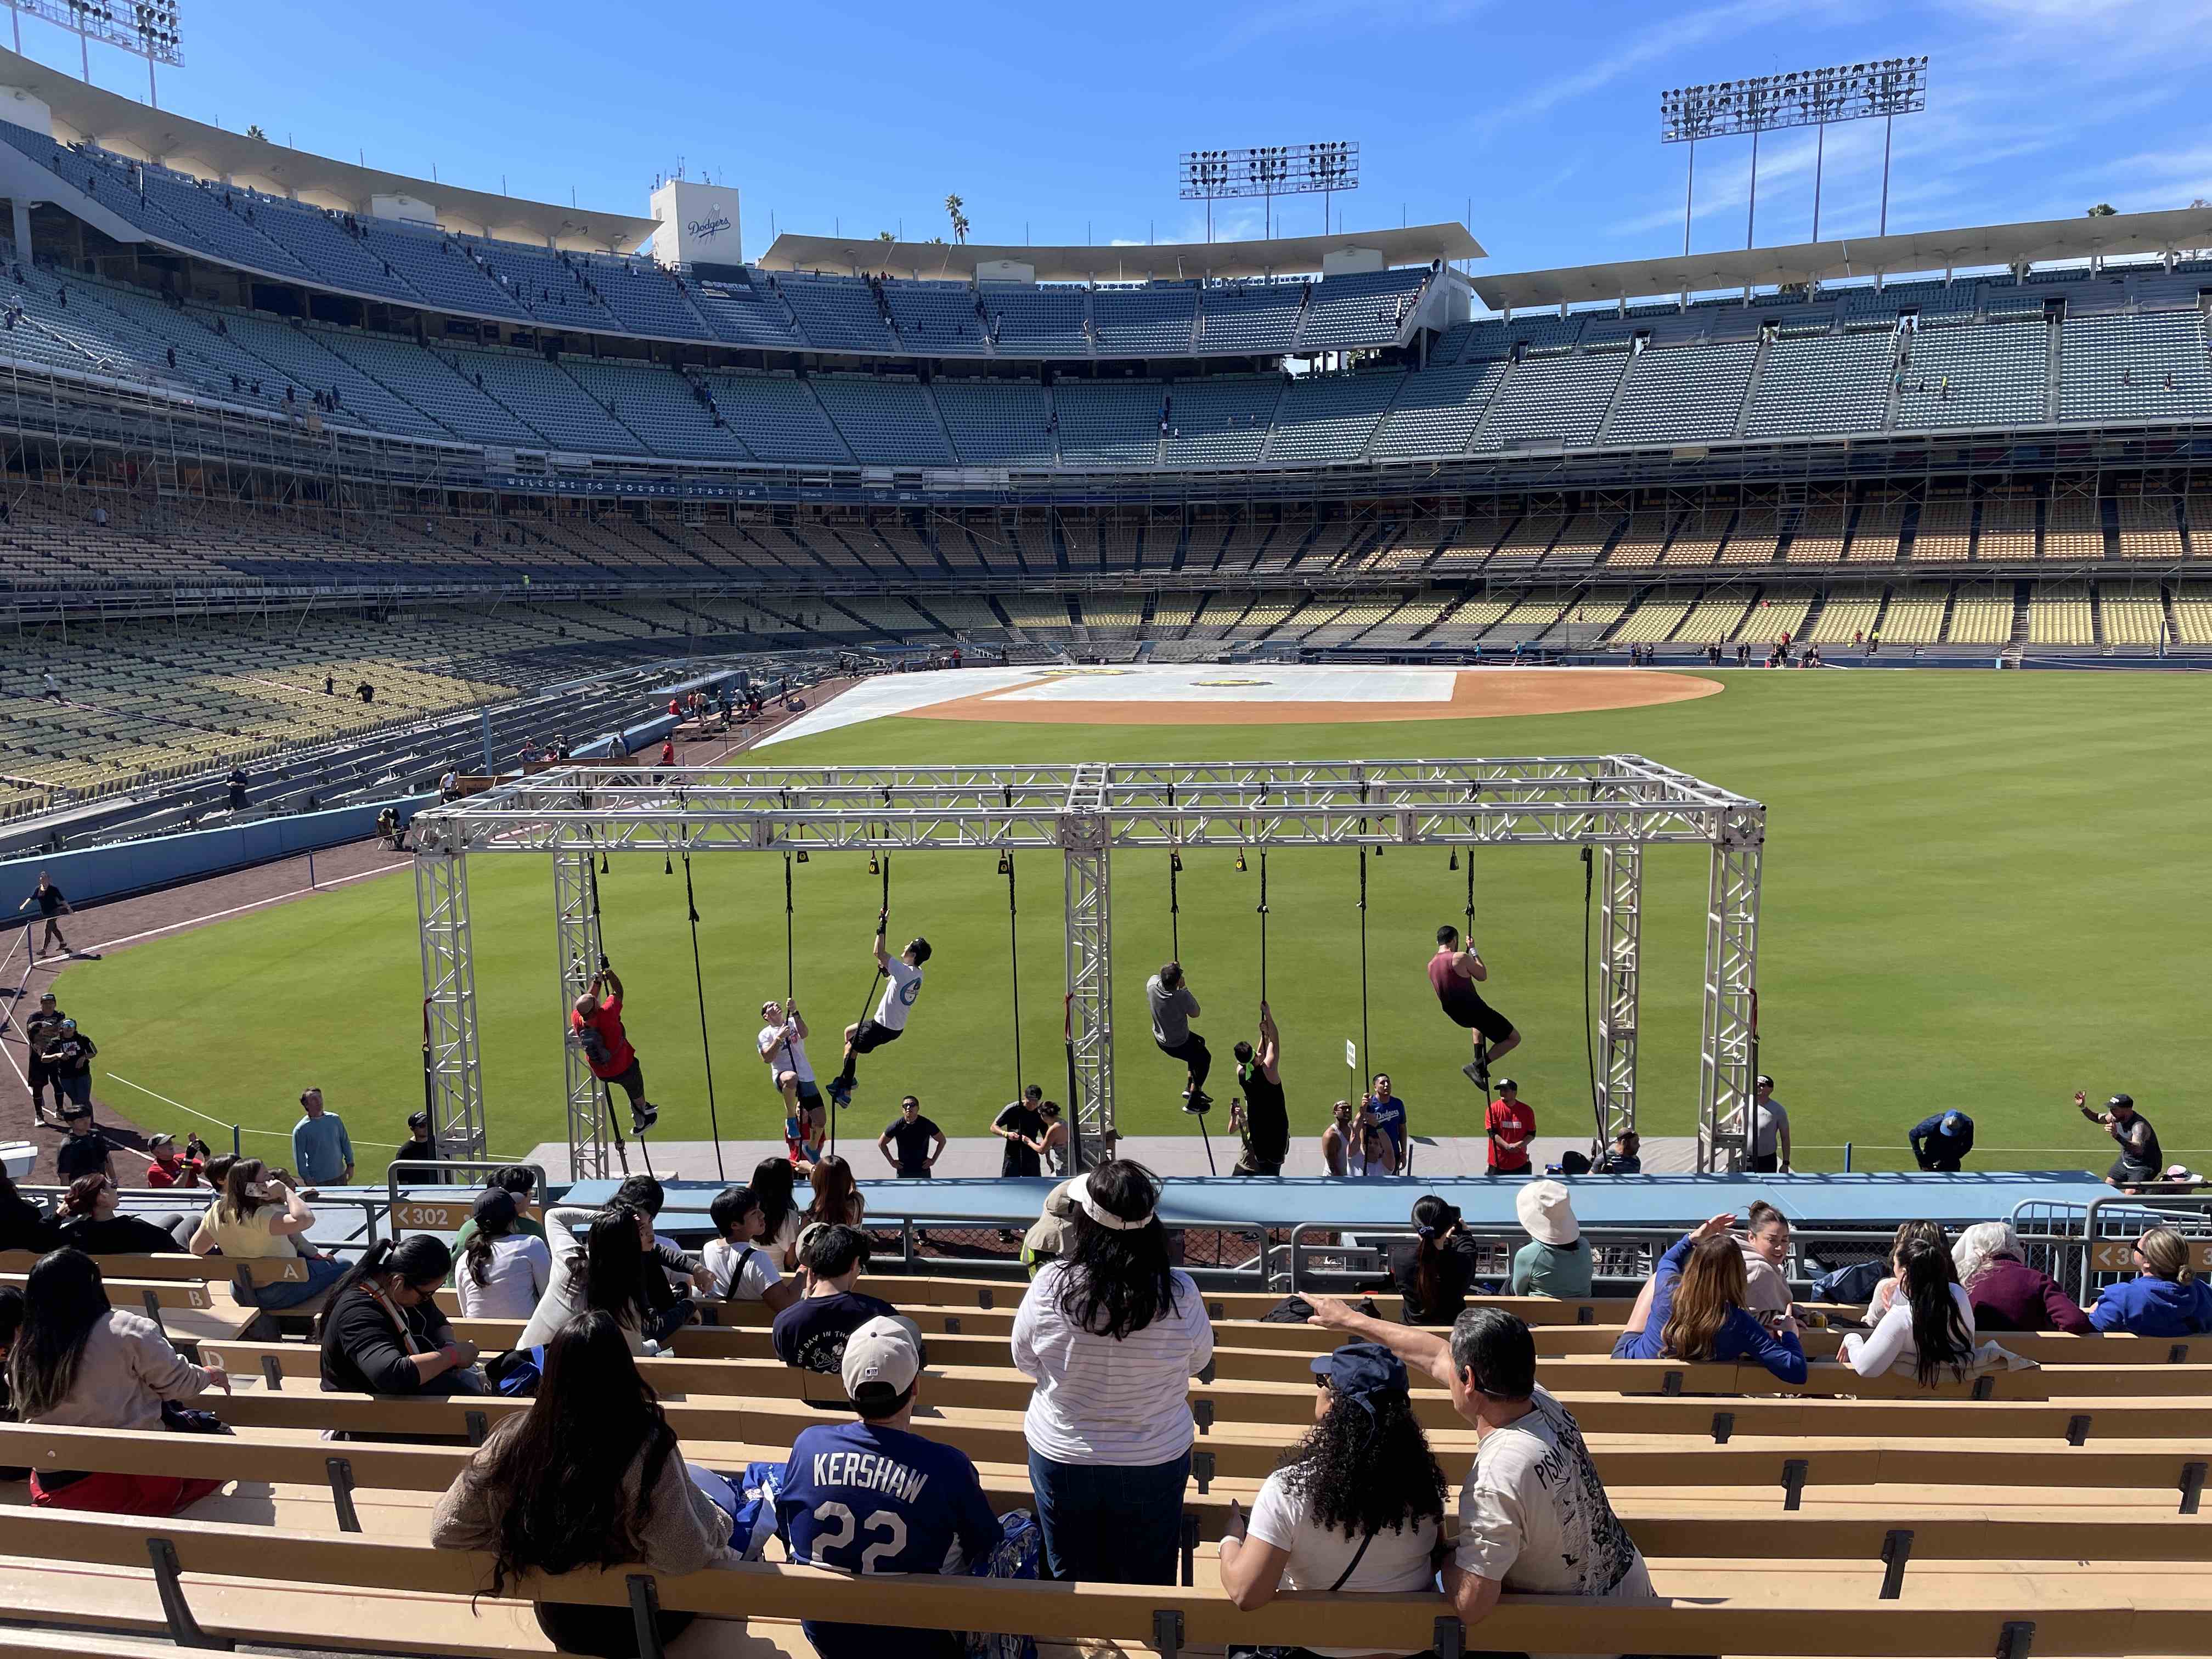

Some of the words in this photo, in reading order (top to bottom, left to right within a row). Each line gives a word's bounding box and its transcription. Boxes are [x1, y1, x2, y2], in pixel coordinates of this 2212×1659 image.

[688, 217, 731, 238] Dodgers
[507, 478, 575, 488] WELCOME
[616, 484, 675, 493] DODGER
[688, 487, 756, 496] STADIUM
[1376, 1109, 1400, 1122] Dodgers
[413, 1208, 448, 1225] 302
[283, 1263, 299, 1279] A
[188, 1290, 203, 1306] B
[804, 1334, 819, 1349] DAY
[204, 1351, 224, 1369] D
[814, 1452, 929, 1504] KERSHAW
[810, 1500, 909, 1576] 22
